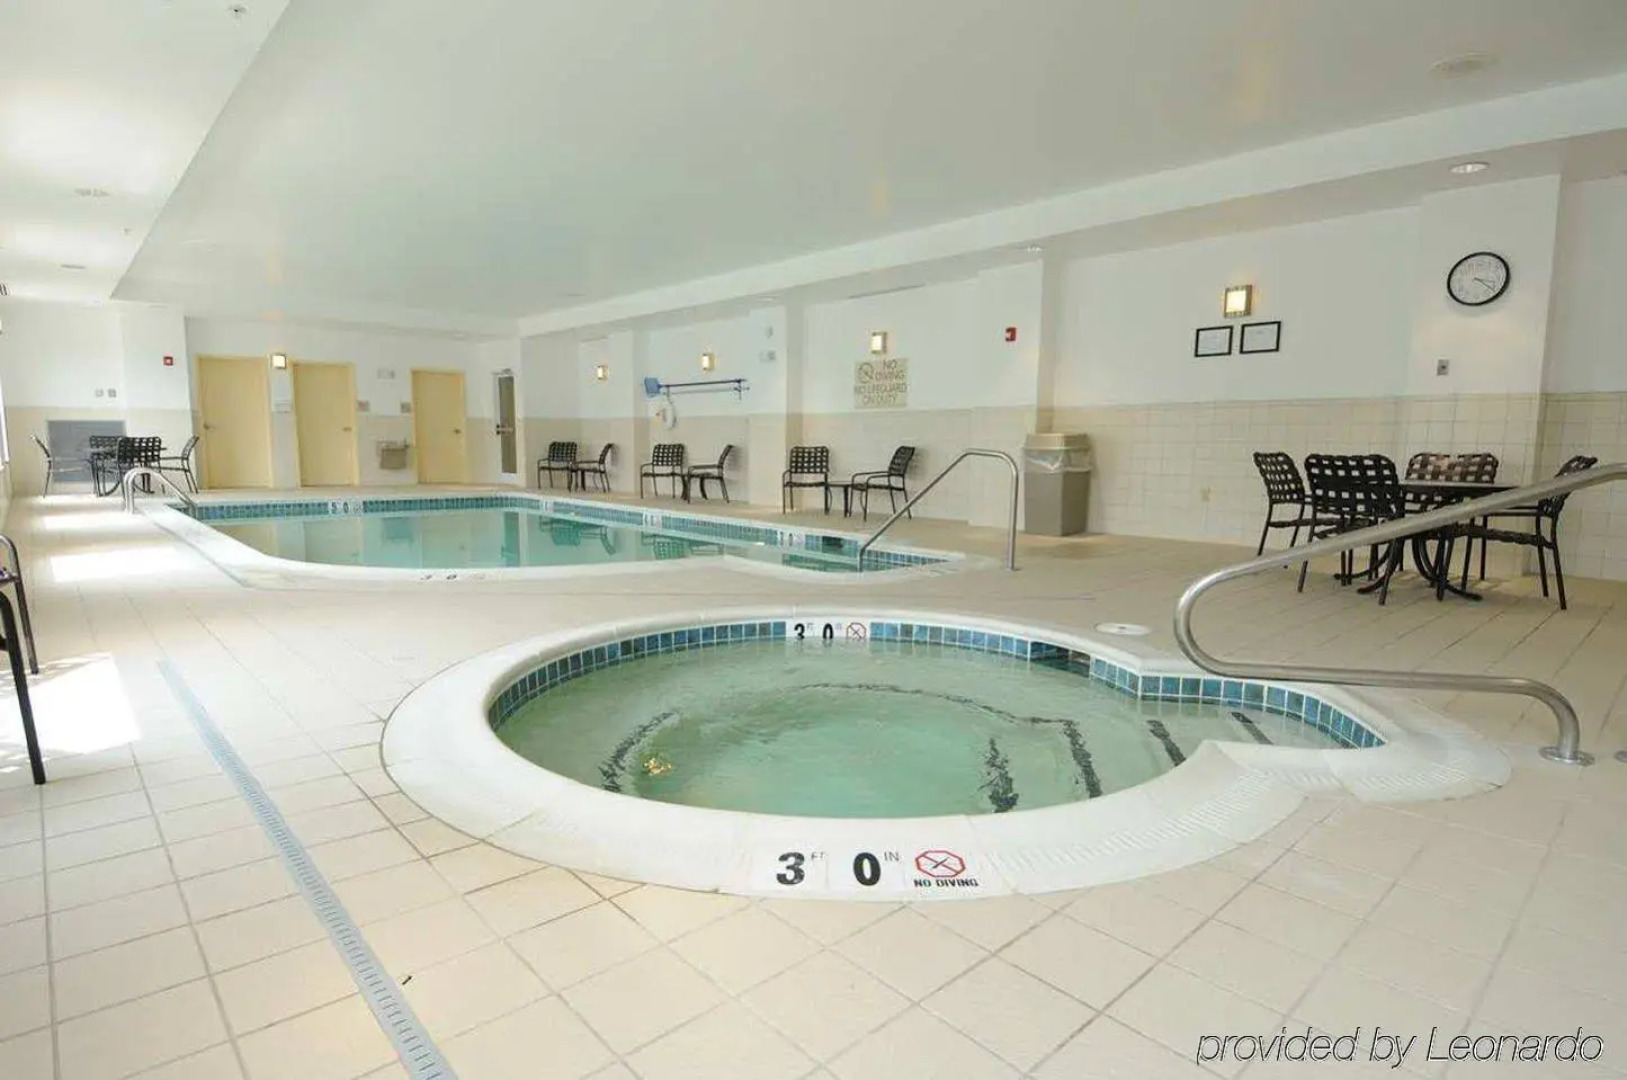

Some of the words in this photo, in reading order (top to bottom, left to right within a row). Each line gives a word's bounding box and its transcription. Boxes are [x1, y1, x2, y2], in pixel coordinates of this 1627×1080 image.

[882, 358, 898, 369] NO
[854, 385, 867, 394] NO
[776, 852, 805, 885] 3
[853, 852, 881, 886] 0
[884, 851, 900, 862] IN
[914, 878, 932, 887] NO
[936, 878, 979, 887] DIVING
